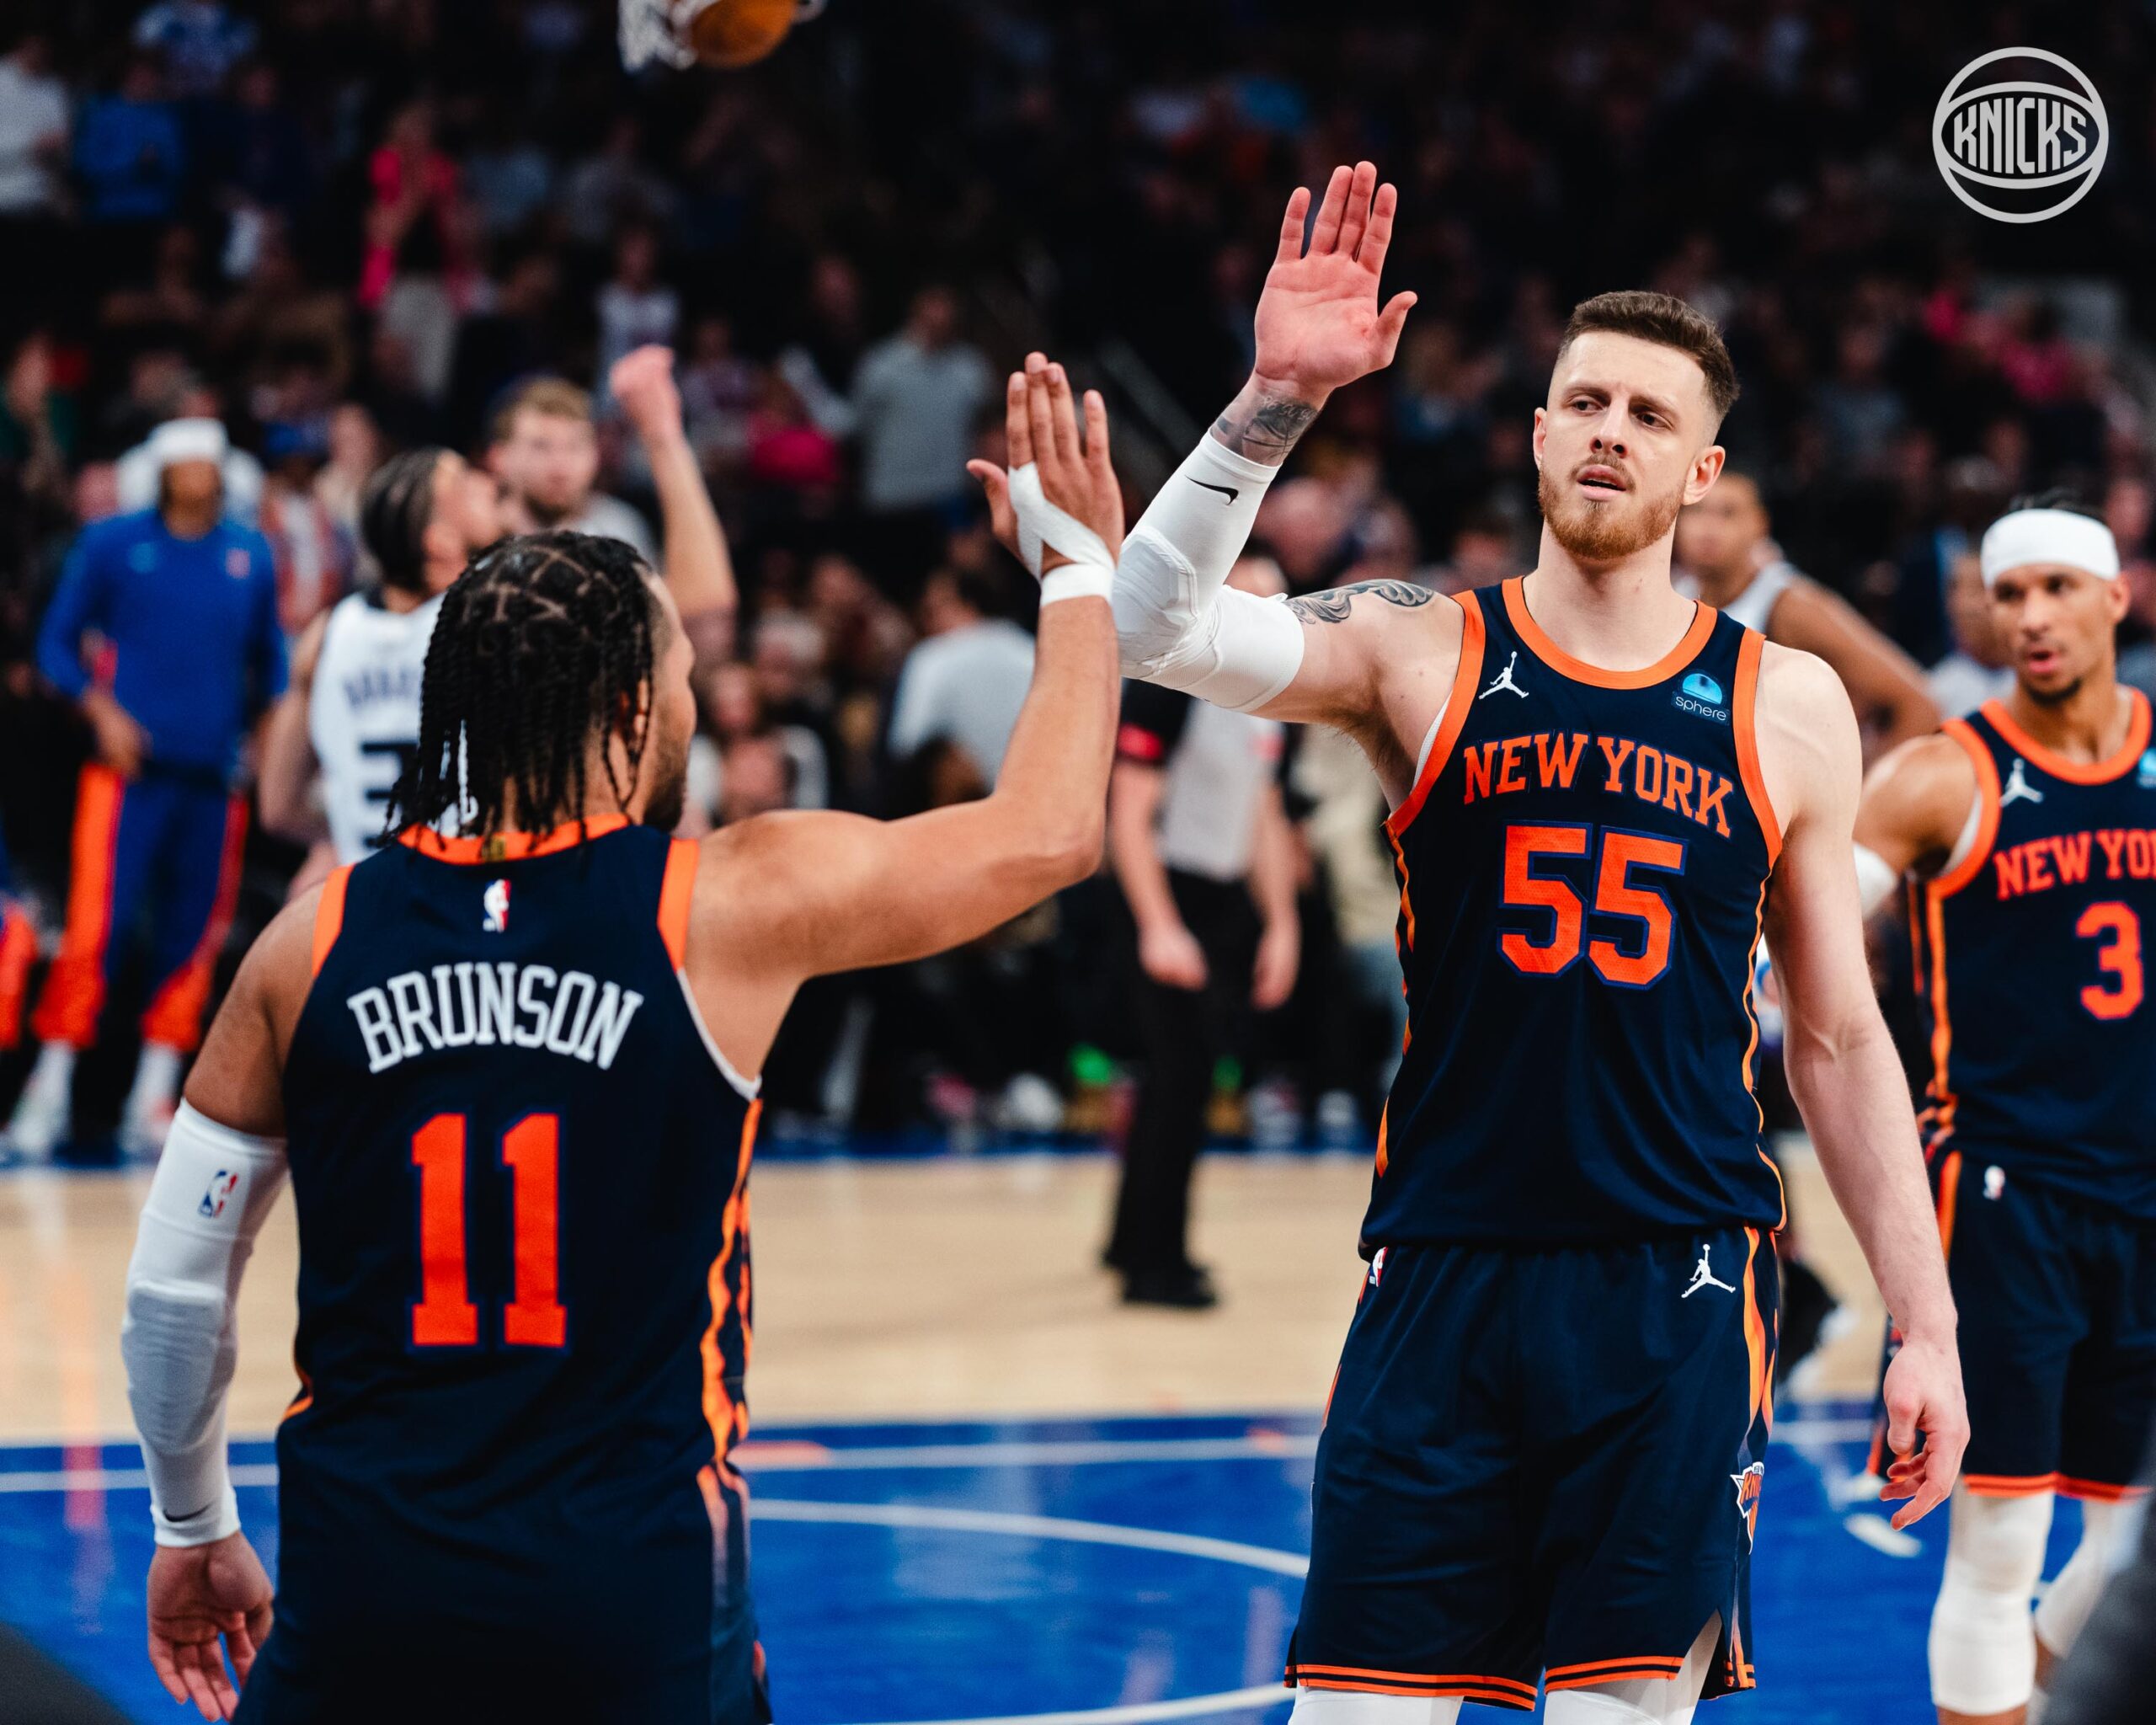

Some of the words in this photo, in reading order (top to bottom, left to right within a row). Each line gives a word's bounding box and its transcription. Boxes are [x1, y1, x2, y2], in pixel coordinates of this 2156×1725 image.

[1675, 696, 1727, 721] sphere
[1463, 732, 1589, 804] NEW
[1597, 736, 1734, 838] YORK
[1498, 822, 1685, 990] 55
[1993, 831, 2090, 900] NEW
[2095, 828, 2156, 880] YO
[2074, 900, 2144, 1021] 3
[346, 962, 644, 1074] BRUNSON
[408, 1108, 569, 1349] 11
